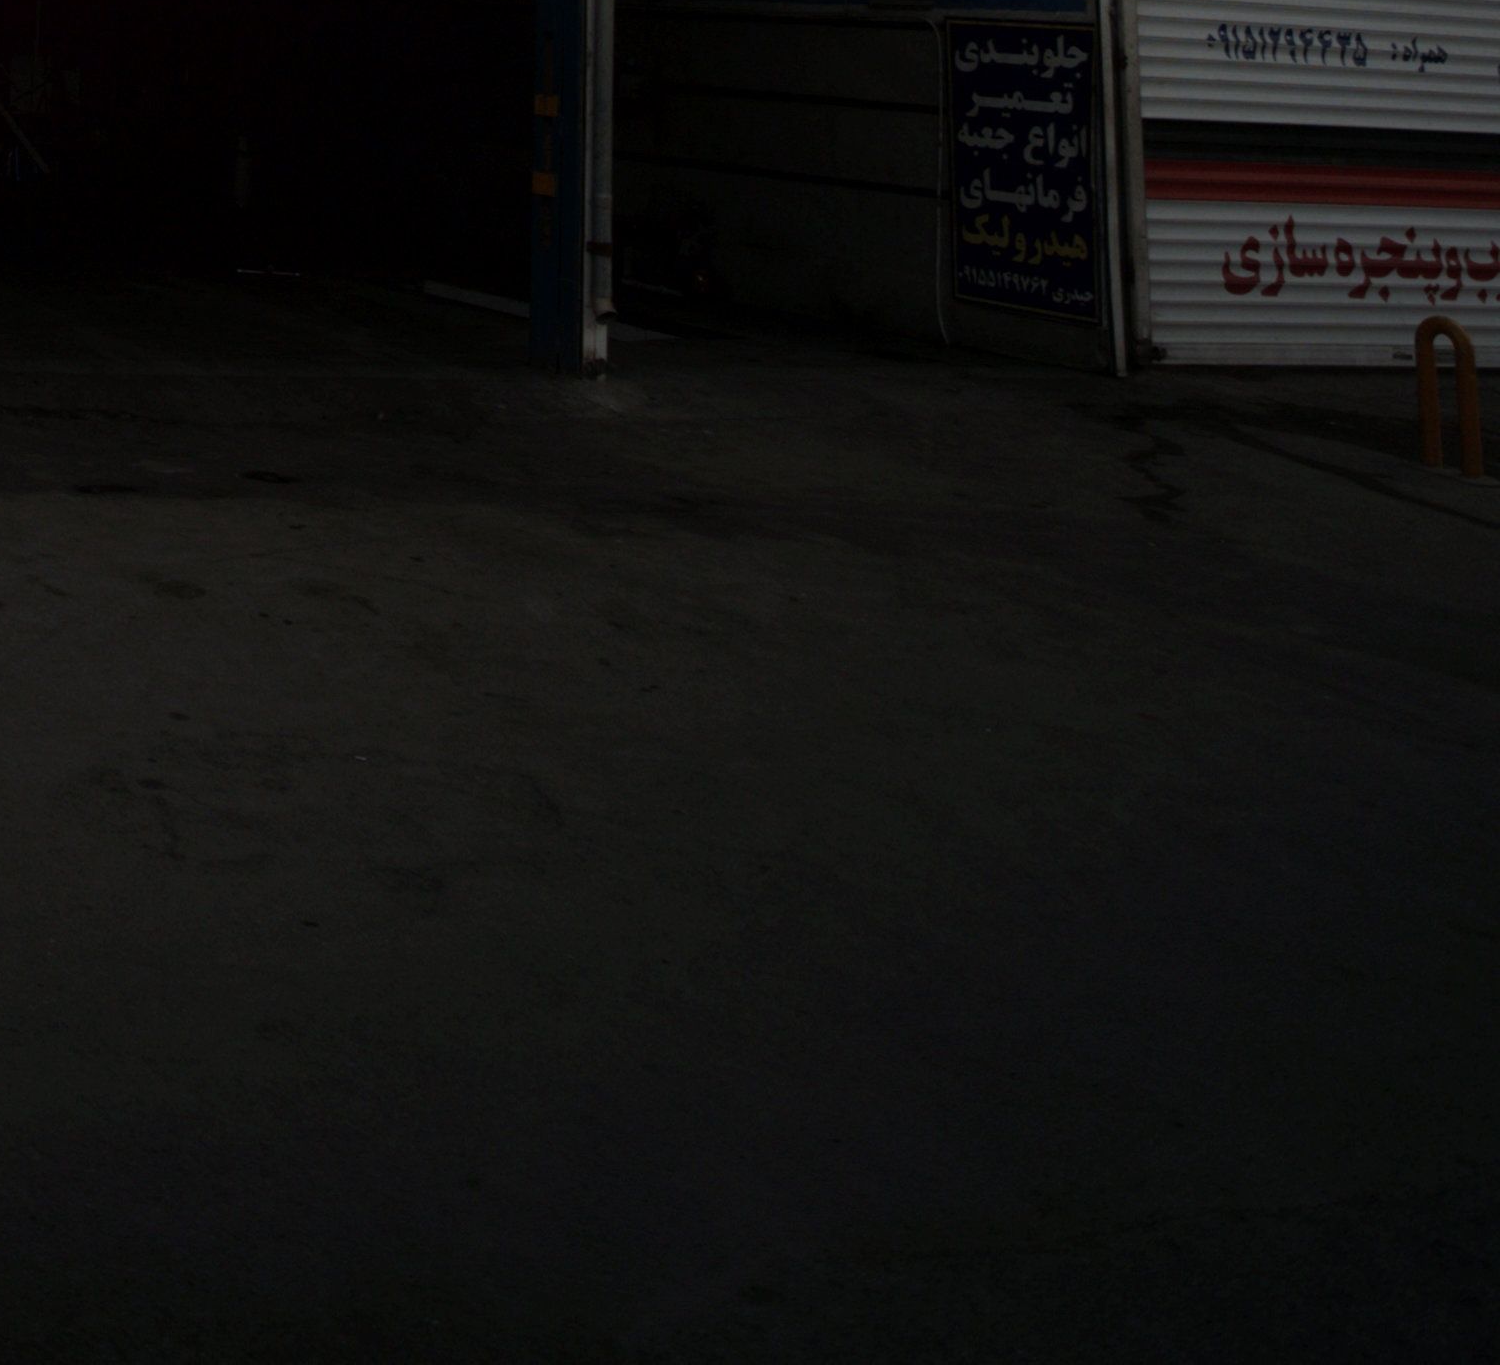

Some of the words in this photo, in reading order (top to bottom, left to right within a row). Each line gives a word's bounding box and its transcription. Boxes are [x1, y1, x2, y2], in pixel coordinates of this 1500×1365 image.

[953, 34, 1091, 80] جلوبندی
[964, 80, 1075, 118] تعمیر
[956, 121, 1016, 161] جعبه
[1022, 121, 1088, 168] انواع
[959, 164, 1090, 223] فرمانهای
[961, 212, 1090, 268] هیدرولیک
[1221, 214, 1329, 298] سازی
